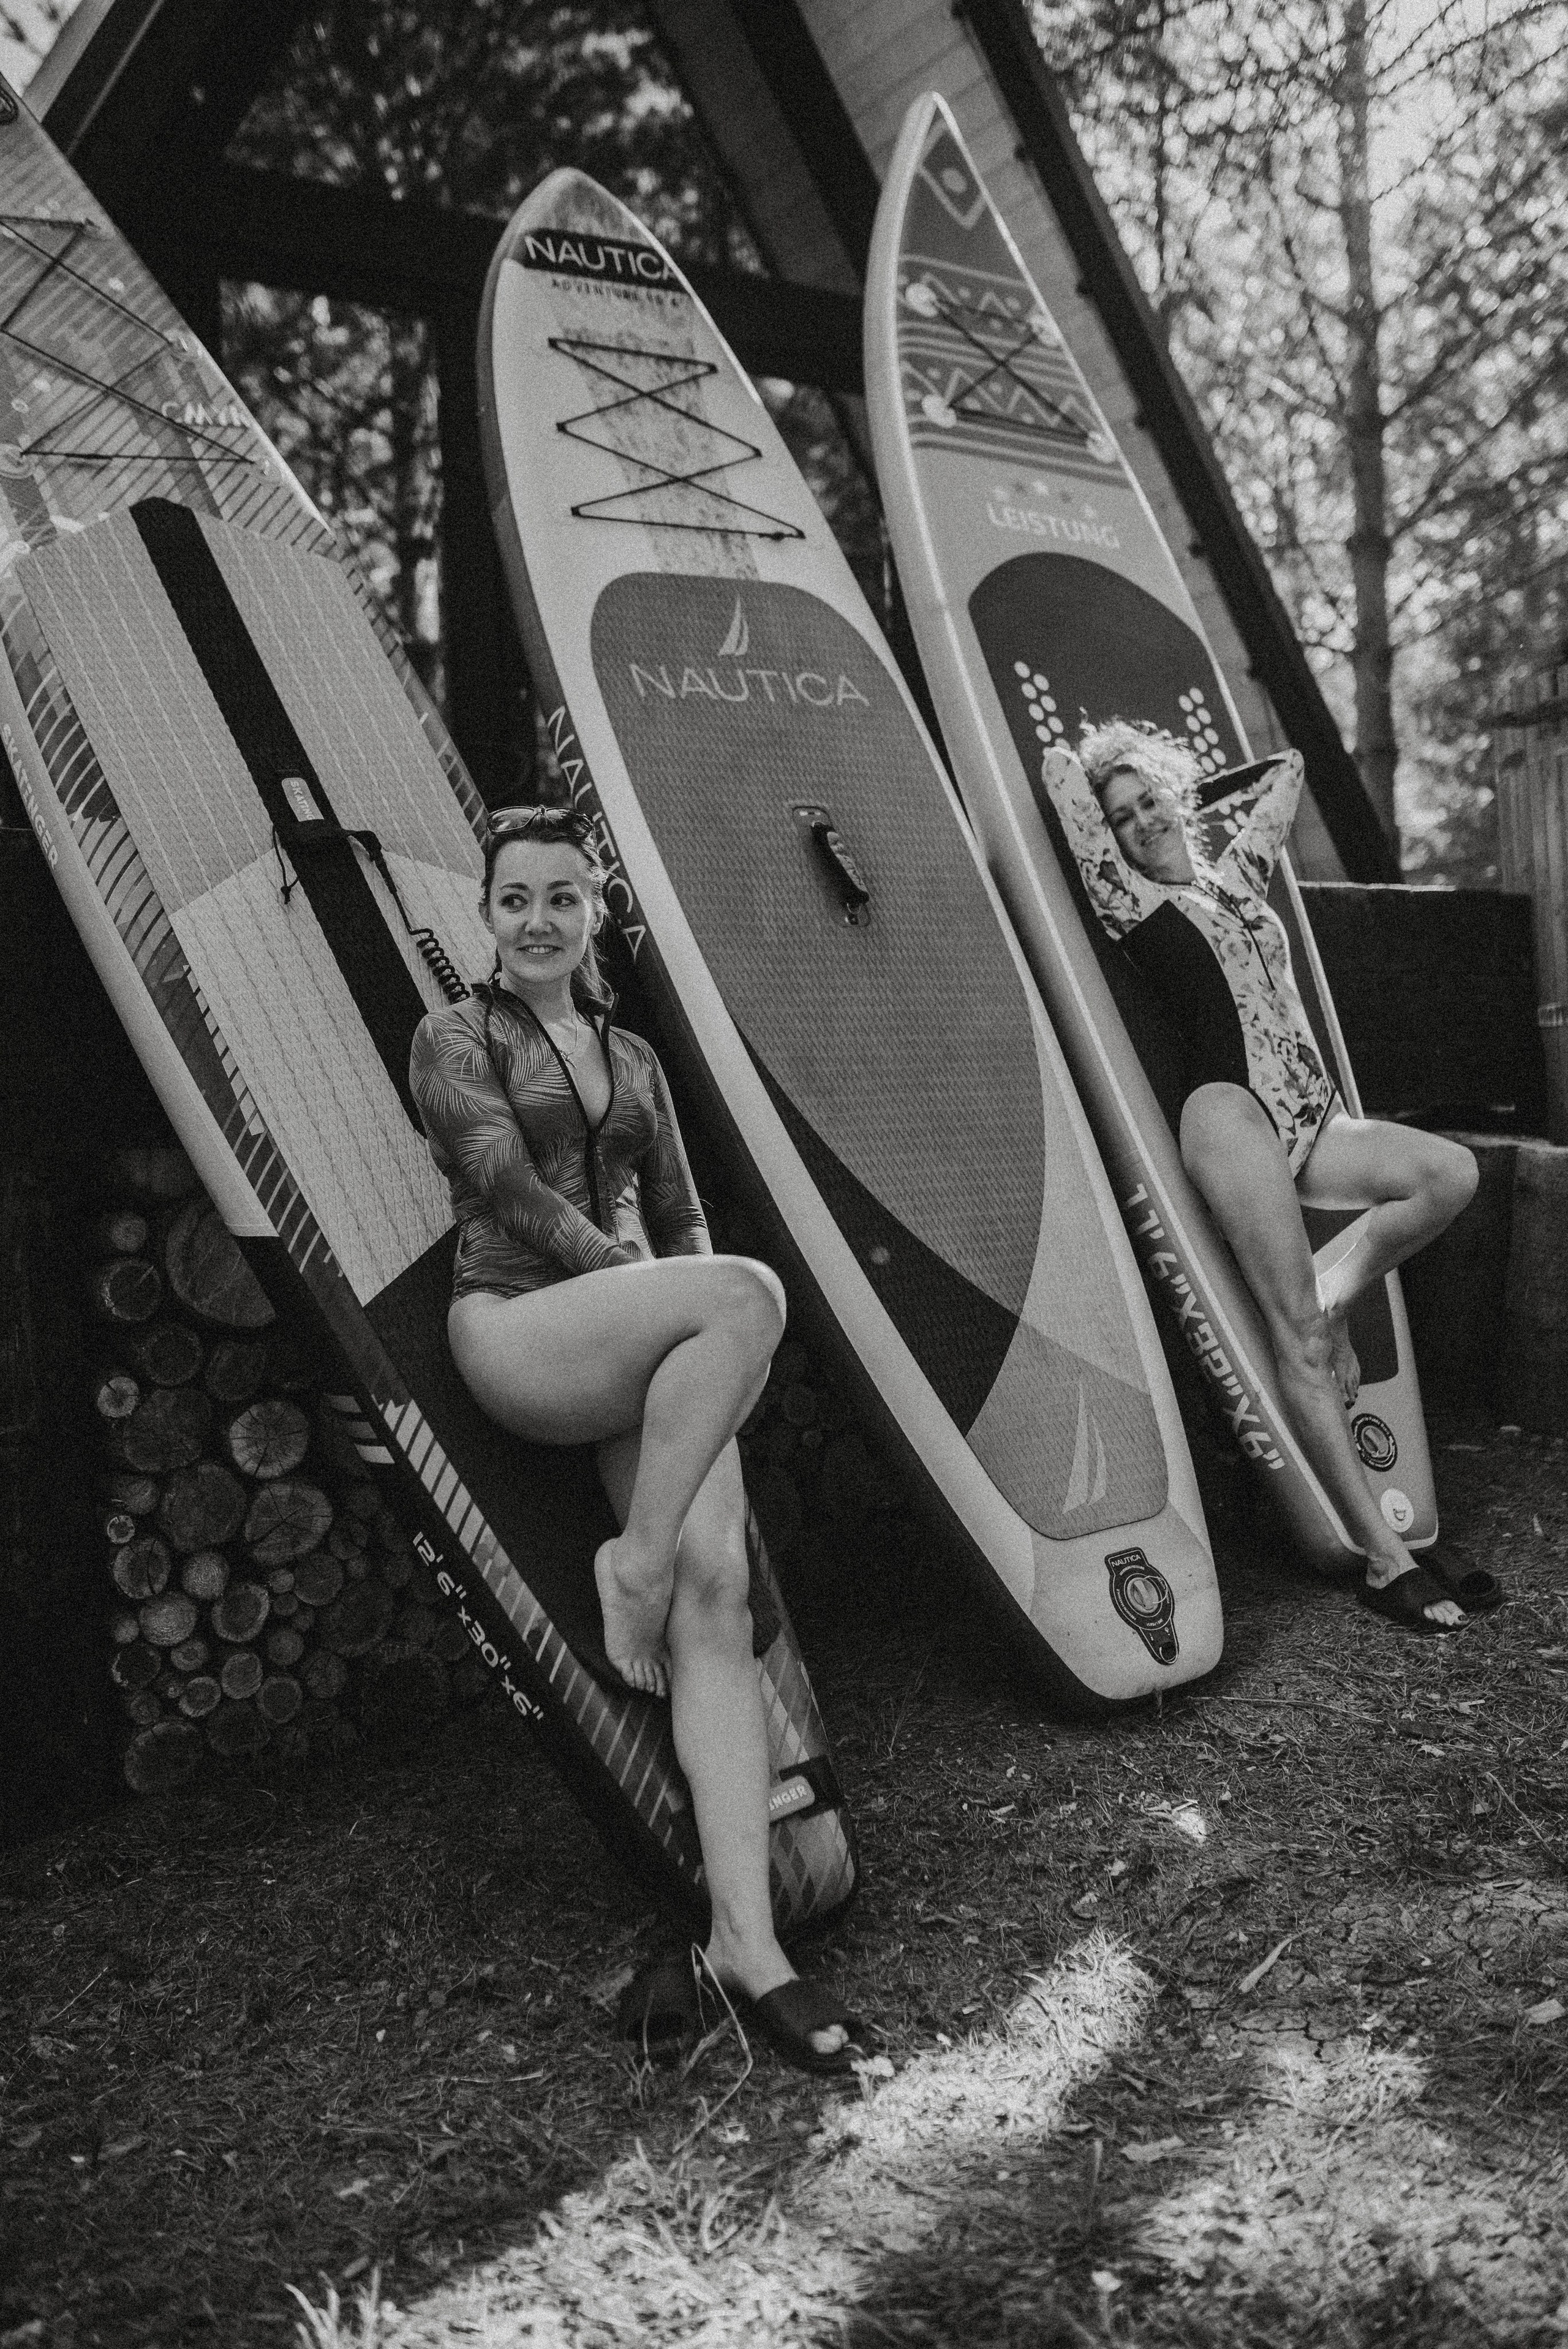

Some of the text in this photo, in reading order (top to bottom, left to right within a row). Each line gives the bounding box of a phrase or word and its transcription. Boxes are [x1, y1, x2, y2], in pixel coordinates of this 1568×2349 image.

[986, 502, 1120, 549] LEISTUNG
[629, 663, 870, 707] NAUTICA
[1111, 1554, 1141, 1567] NAUTICA
